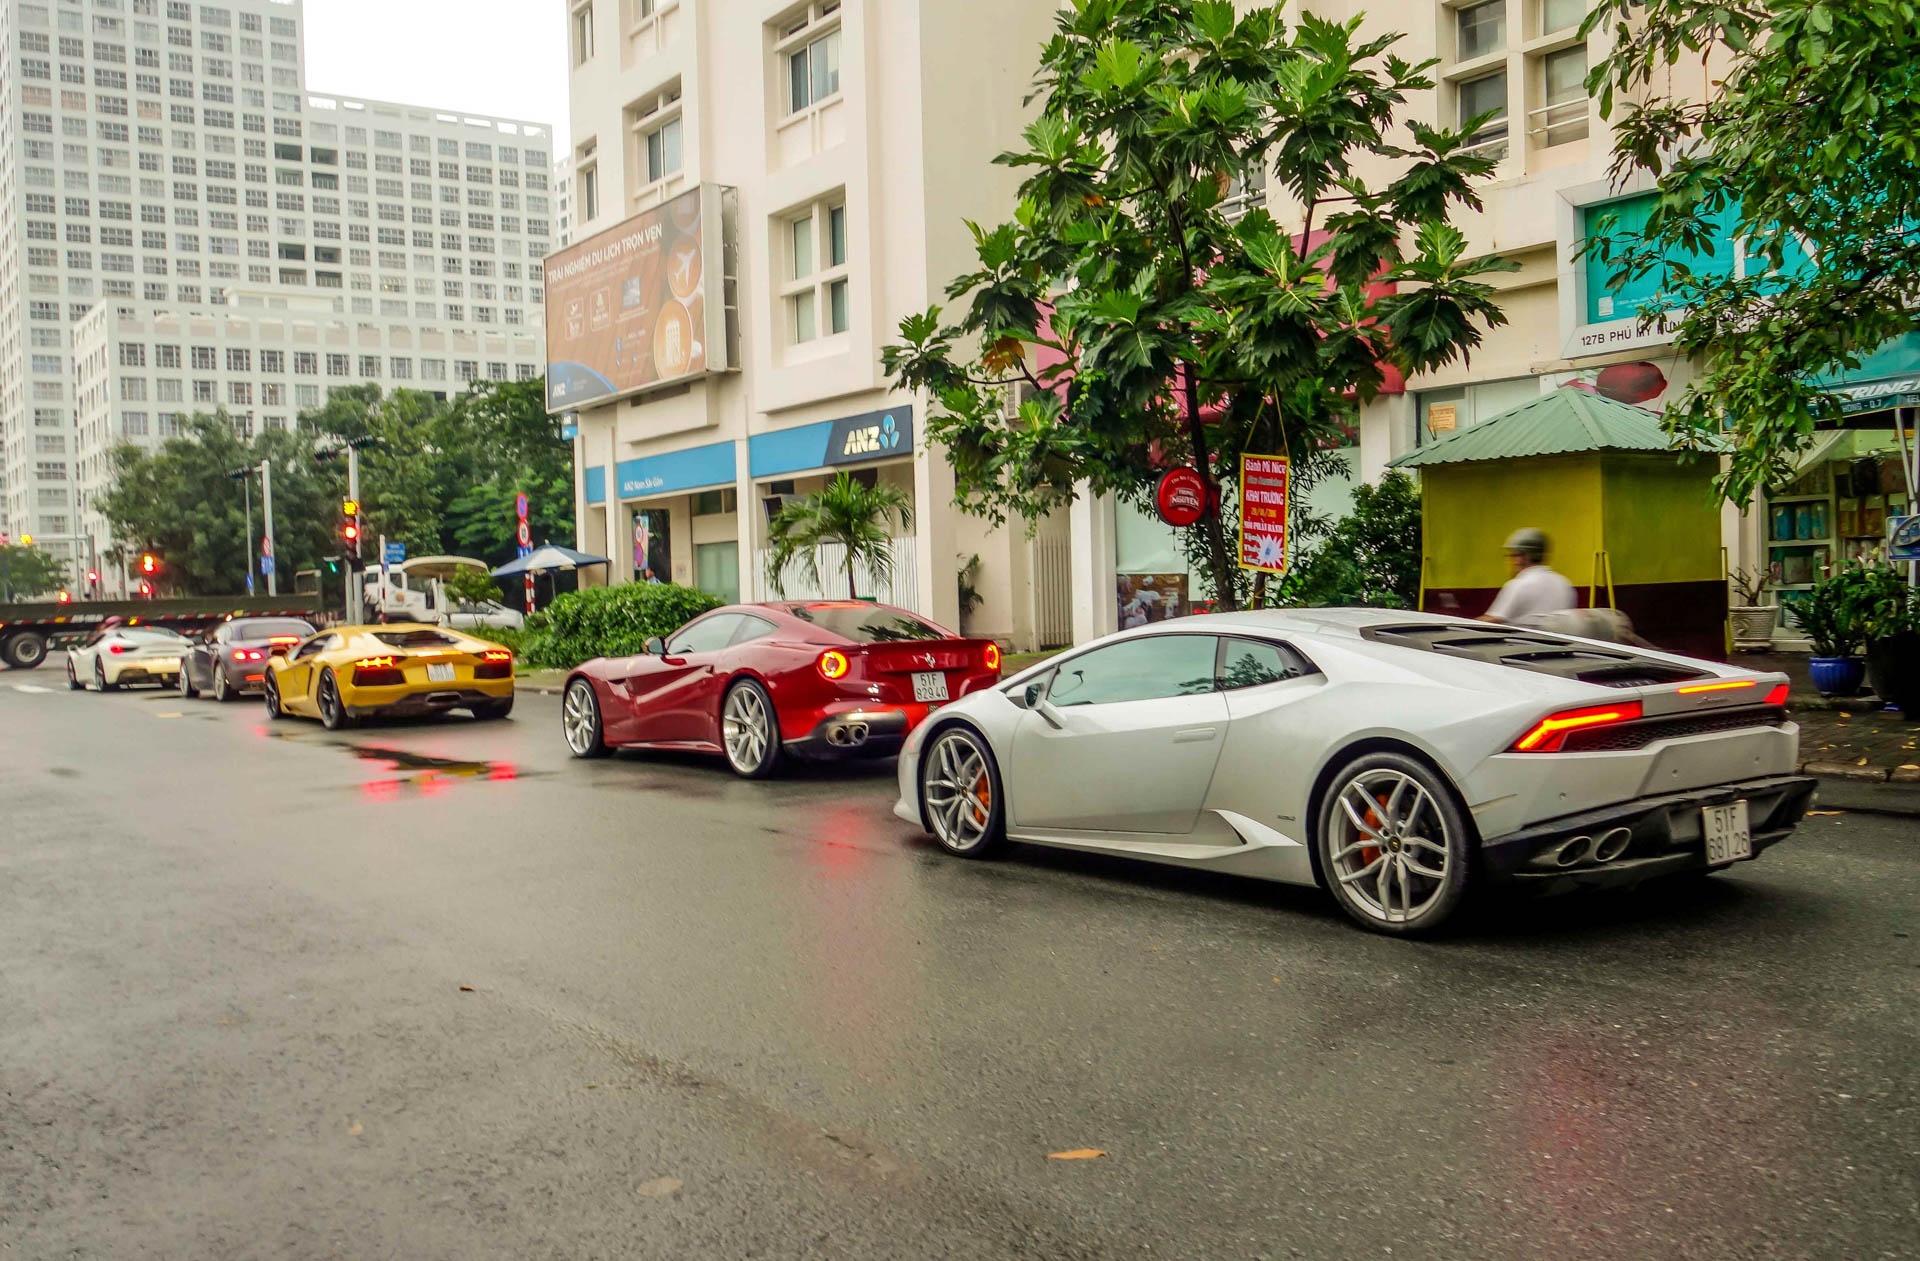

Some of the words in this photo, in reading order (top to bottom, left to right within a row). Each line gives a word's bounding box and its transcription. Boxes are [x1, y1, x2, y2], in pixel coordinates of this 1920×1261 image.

[1582, 333, 1605, 346] 127B
[1610, 325, 1632, 341] PHÚ
[843, 426, 880, 455] ANZ
[1245, 459, 1262, 472] Bánh
[1271, 461, 1287, 475] Nice
[919, 673, 937, 687] 51F
[1714, 806, 1737, 833] 51F
